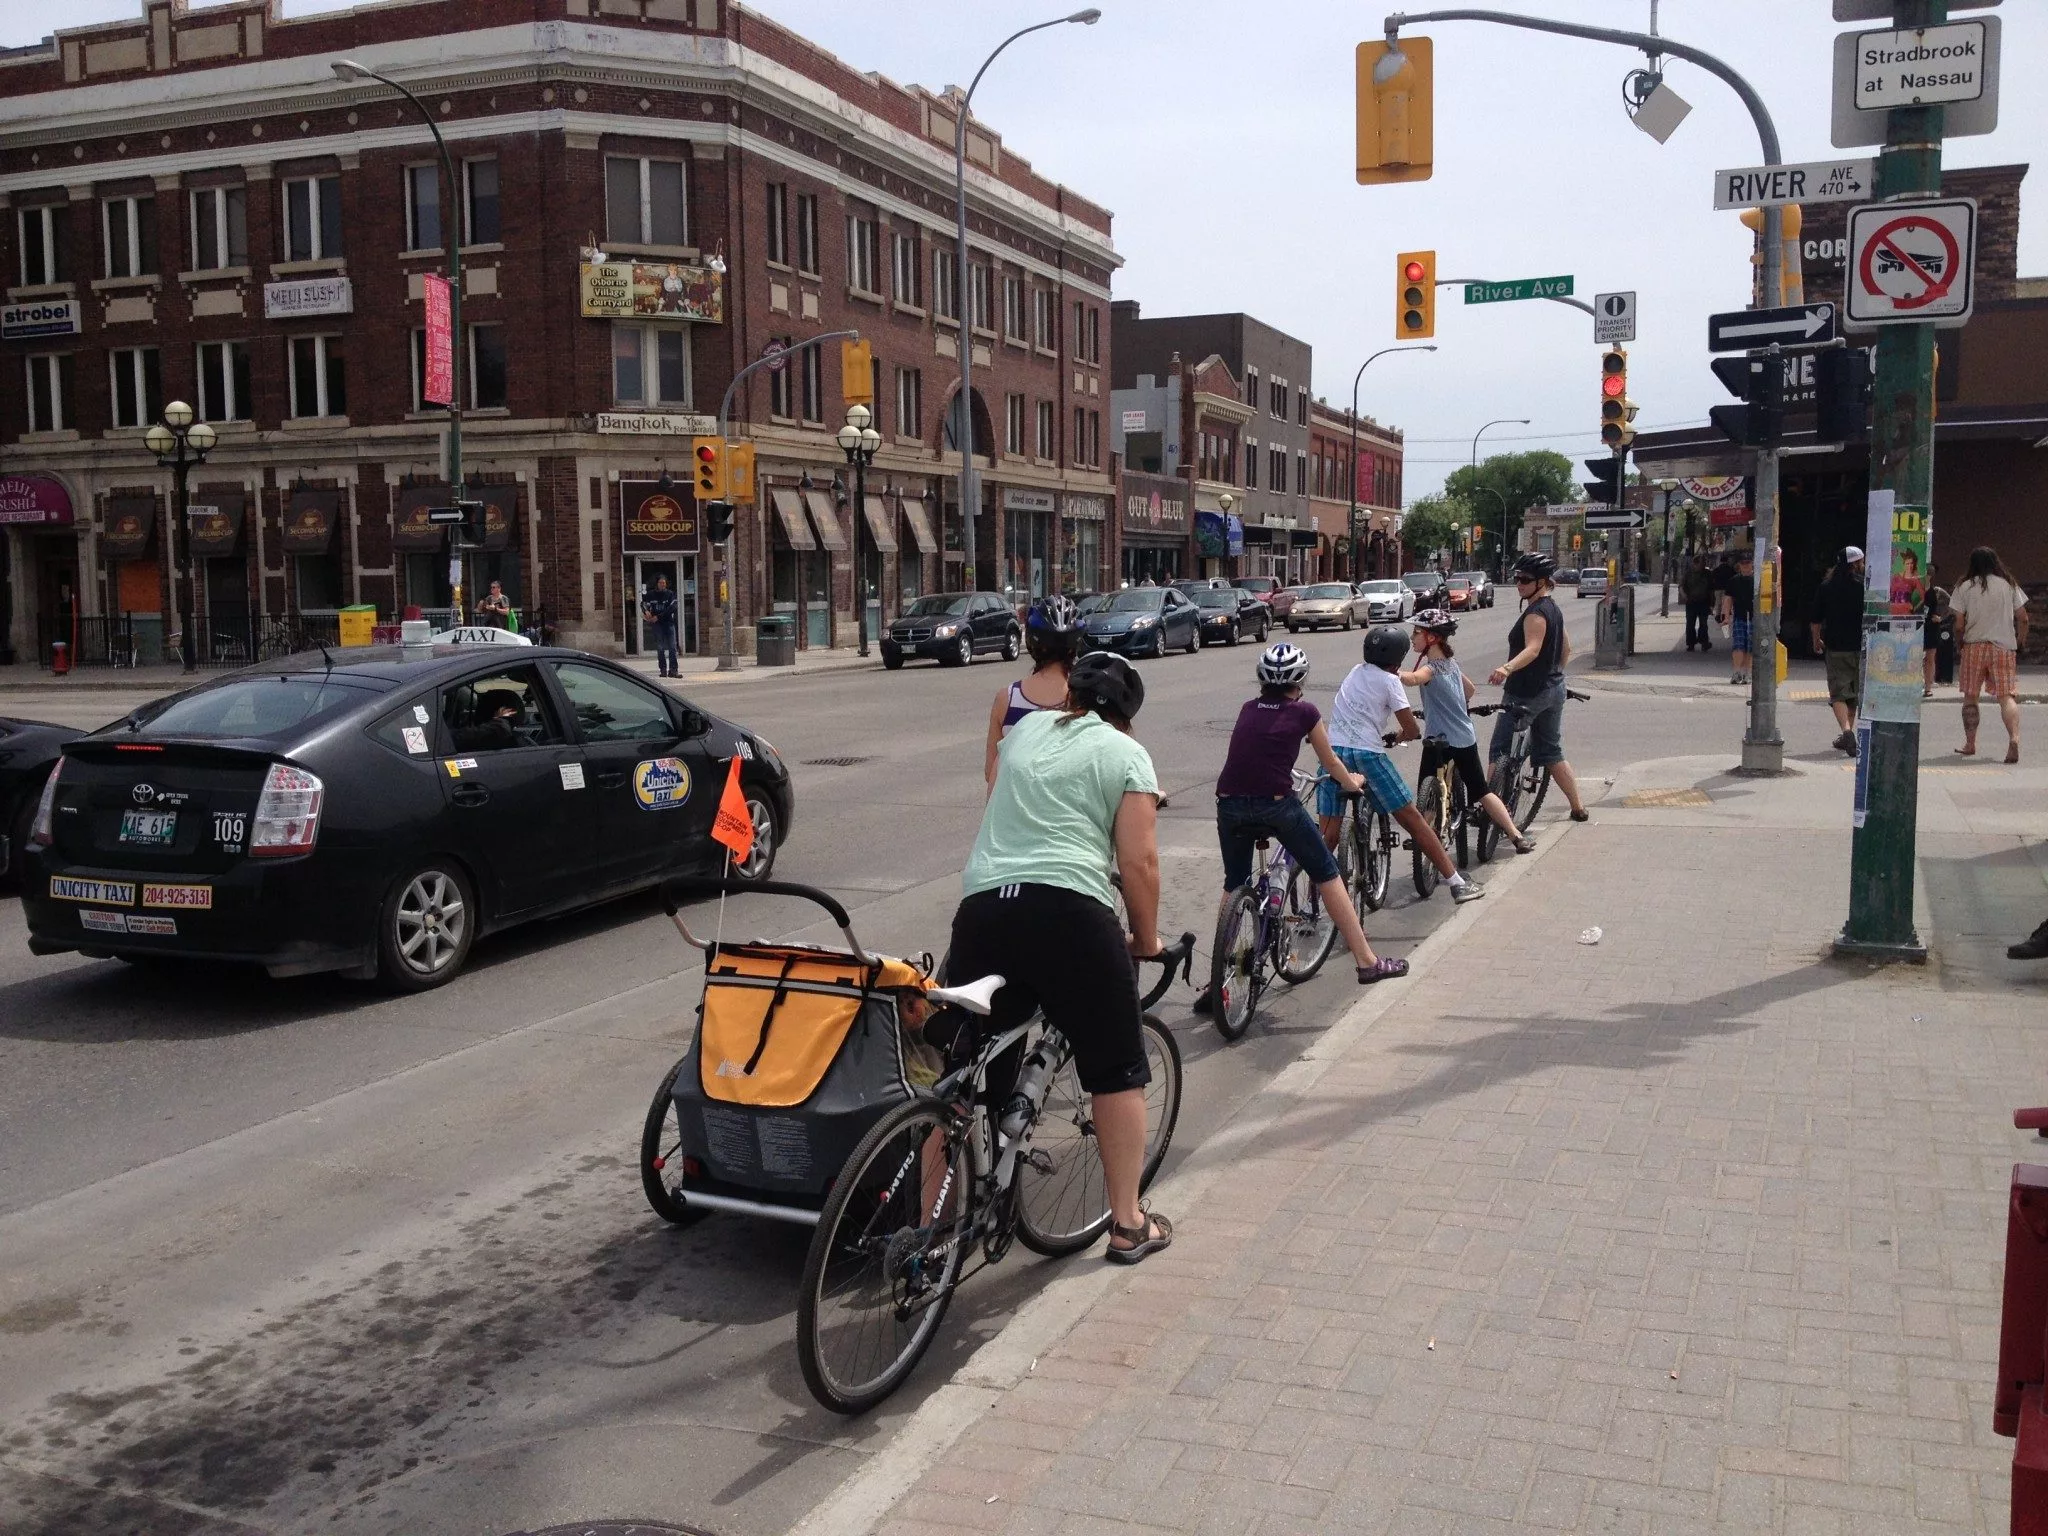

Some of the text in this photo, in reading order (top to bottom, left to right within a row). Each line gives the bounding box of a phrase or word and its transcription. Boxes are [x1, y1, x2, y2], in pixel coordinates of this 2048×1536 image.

[1864, 41, 1976, 66] Stradbrook
[1864, 72, 1973, 92] at Nassau
[1728, 166, 1854, 202] RIVER AVE
[1818, 182, 1844, 196] 470
[600, 267, 618, 277] The
[591, 278, 628, 287] Osborne
[1471, 280, 1567, 301] River Ave
[594, 287, 626, 298] Village
[588, 299, 633, 309] Courtyard
[4, 304, 70, 323] strobel
[1599, 318, 1632, 326] TRANSIT
[1597, 325, 1633, 333] PRIORITY
[1601, 332, 1629, 340] SIGNAL
[600, 415, 672, 432] Bangkok
[1127, 496, 1148, 517] OUT
[1161, 500, 1185, 520] BLUE
[631, 521, 692, 532] SECOND CUP
[455, 629, 496, 642] TAXI
[735, 741, 753, 760] 109
[647, 775, 678, 788] Unicity
[653, 788, 671, 802] Taxi
[151, 817, 174, 835] 615
[214, 818, 244, 842] 109
[52, 878, 133, 903] UNICITY TAXI
[932, 1167, 954, 1219] GIANT
